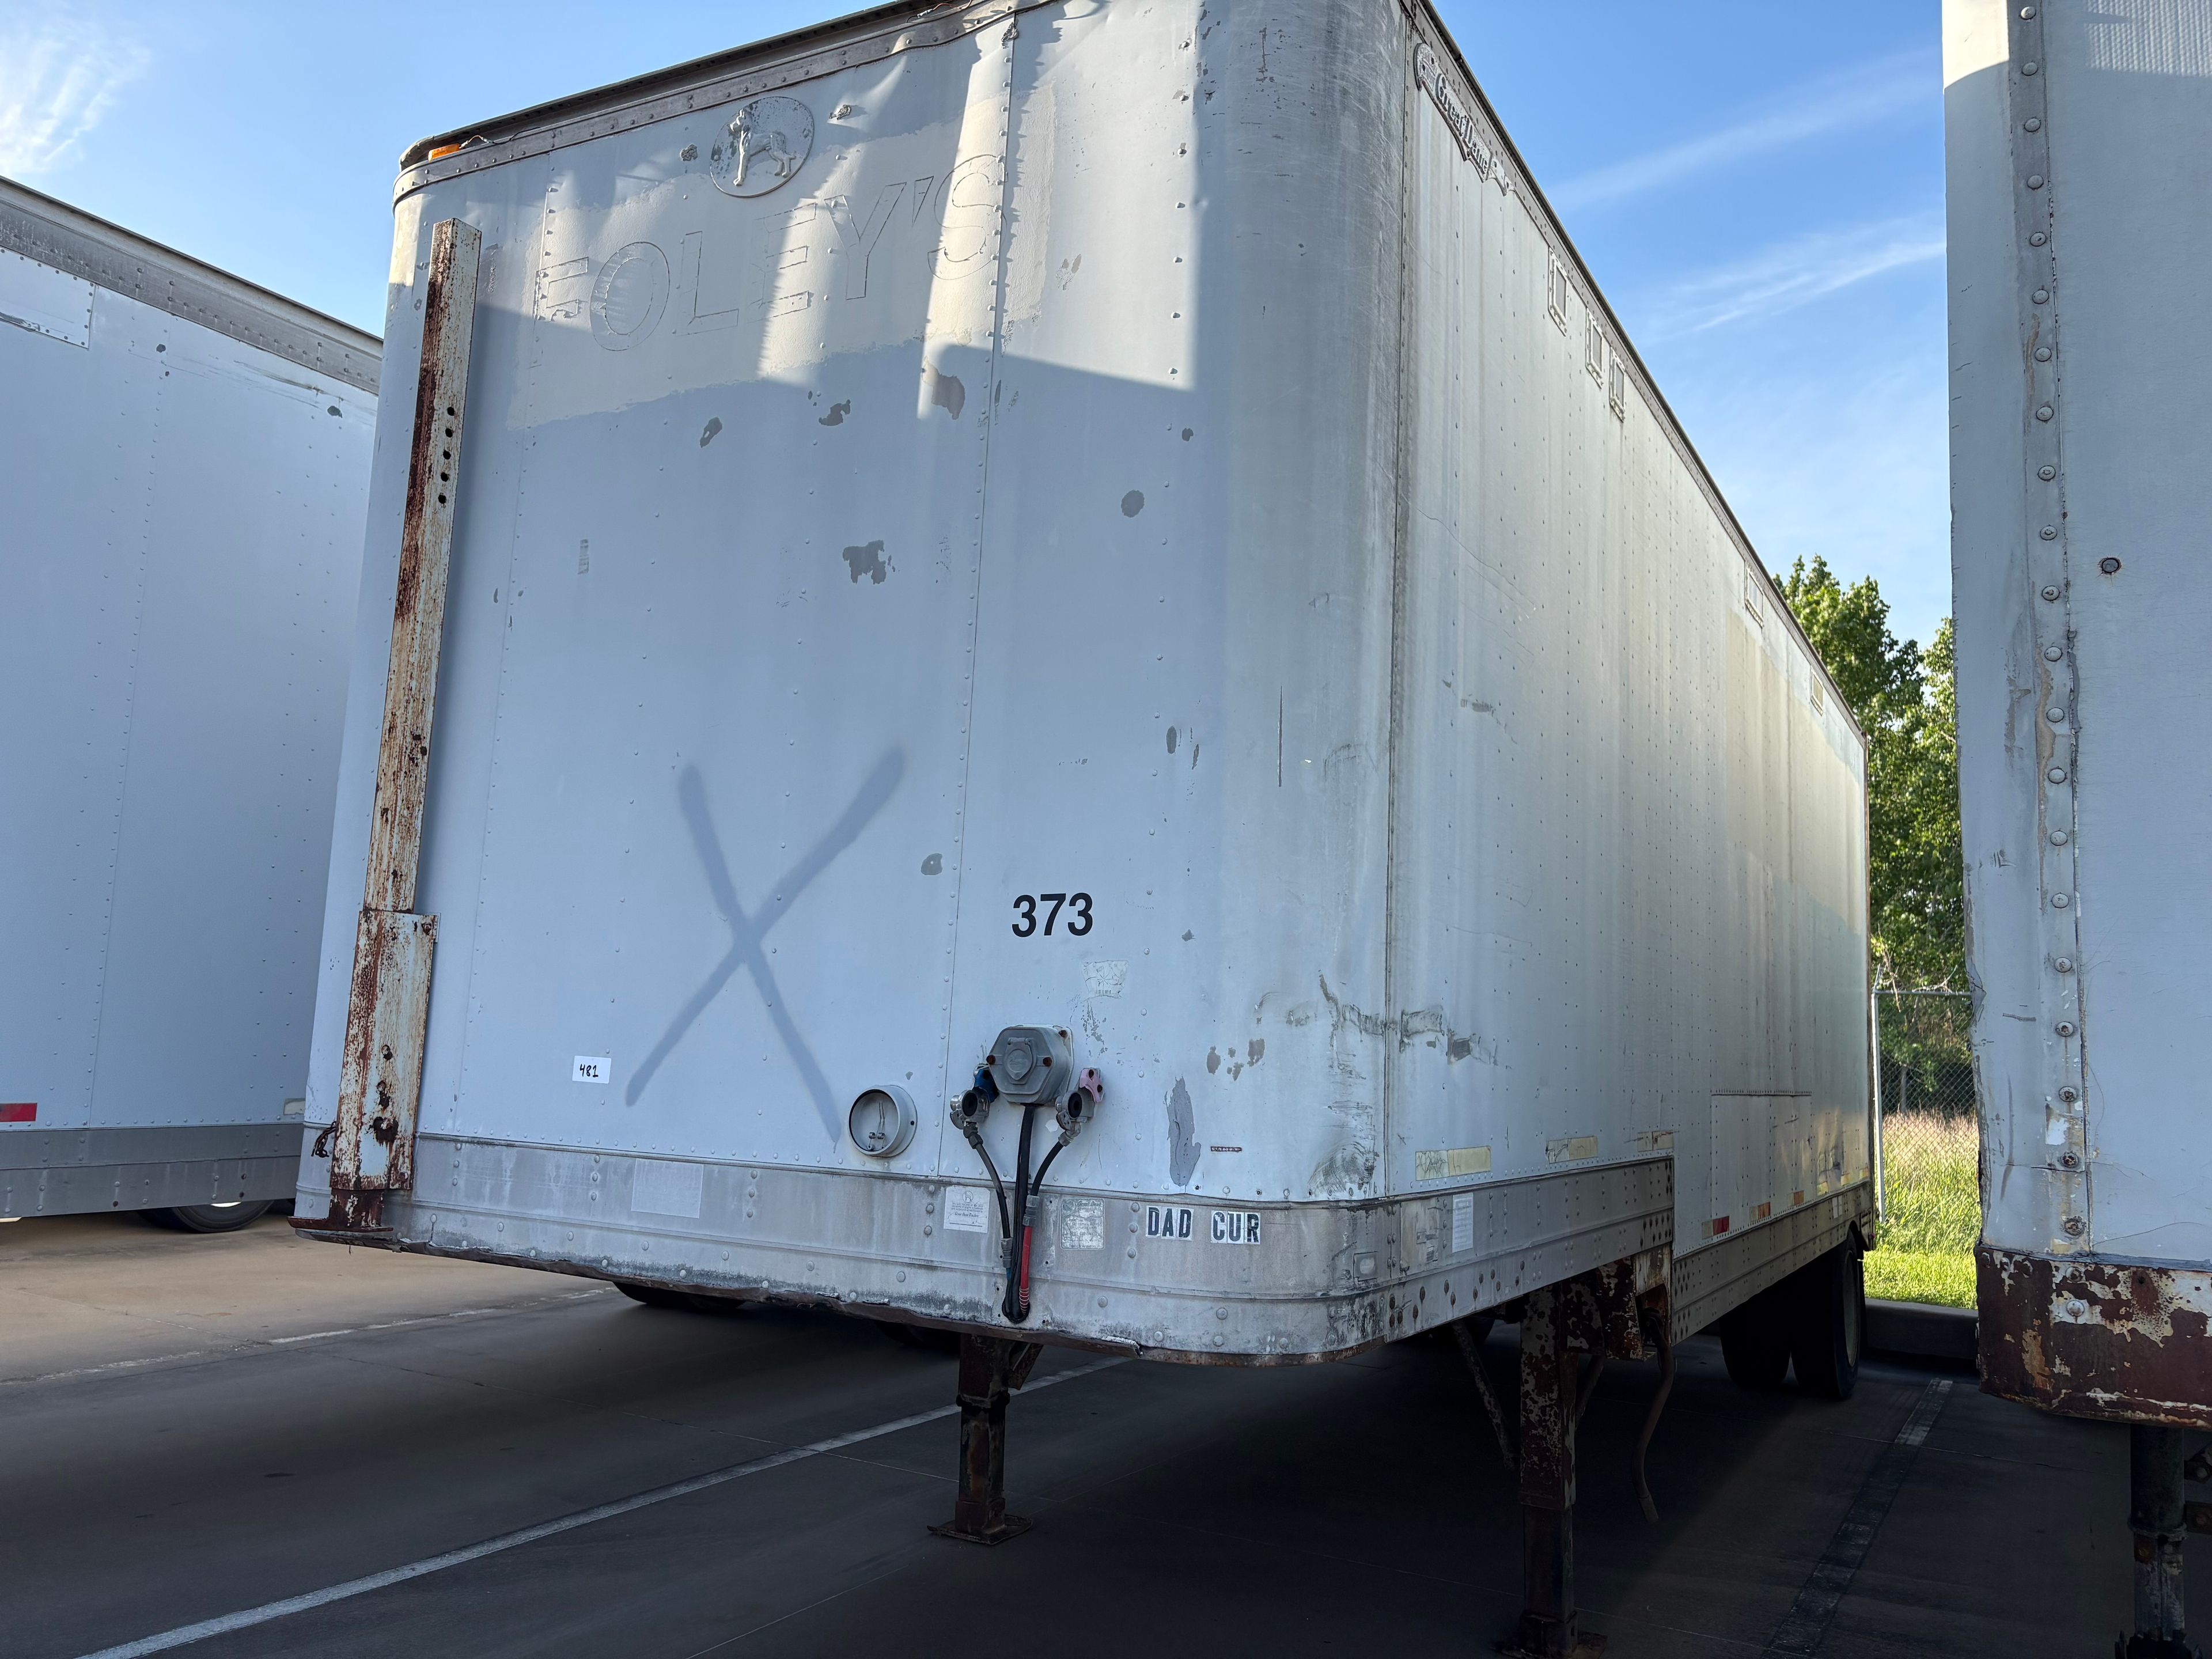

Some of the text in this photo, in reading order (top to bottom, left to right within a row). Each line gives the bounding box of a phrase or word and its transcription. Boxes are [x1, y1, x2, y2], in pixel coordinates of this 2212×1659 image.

[1012, 892, 1093, 938] 373
[579, 1063, 599, 1078] 481
[1147, 1207, 1260, 1243] DAD CUR
